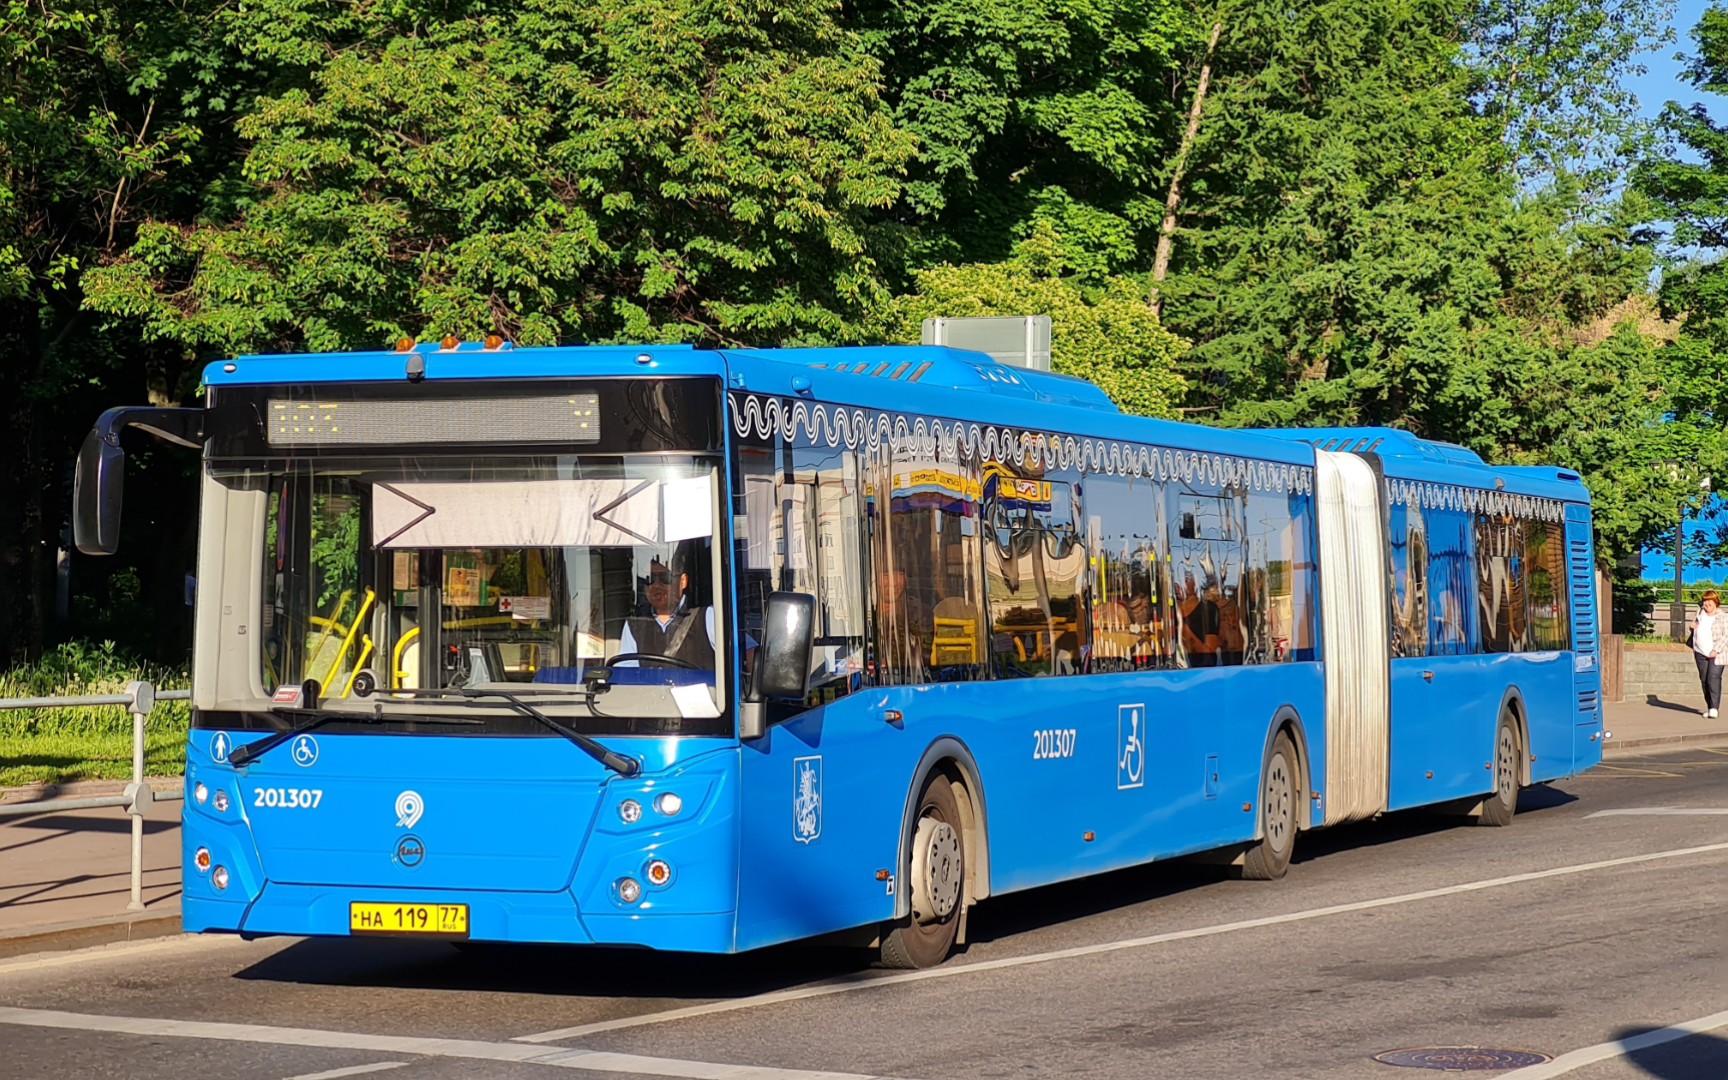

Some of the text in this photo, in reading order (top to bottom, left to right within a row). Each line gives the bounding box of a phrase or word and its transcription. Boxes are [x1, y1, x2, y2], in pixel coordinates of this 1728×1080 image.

[1033, 729, 1076, 759] 201307
[254, 787, 323, 809] 201307
[394, 907, 428, 928] 119
[440, 907, 459, 923] 77
